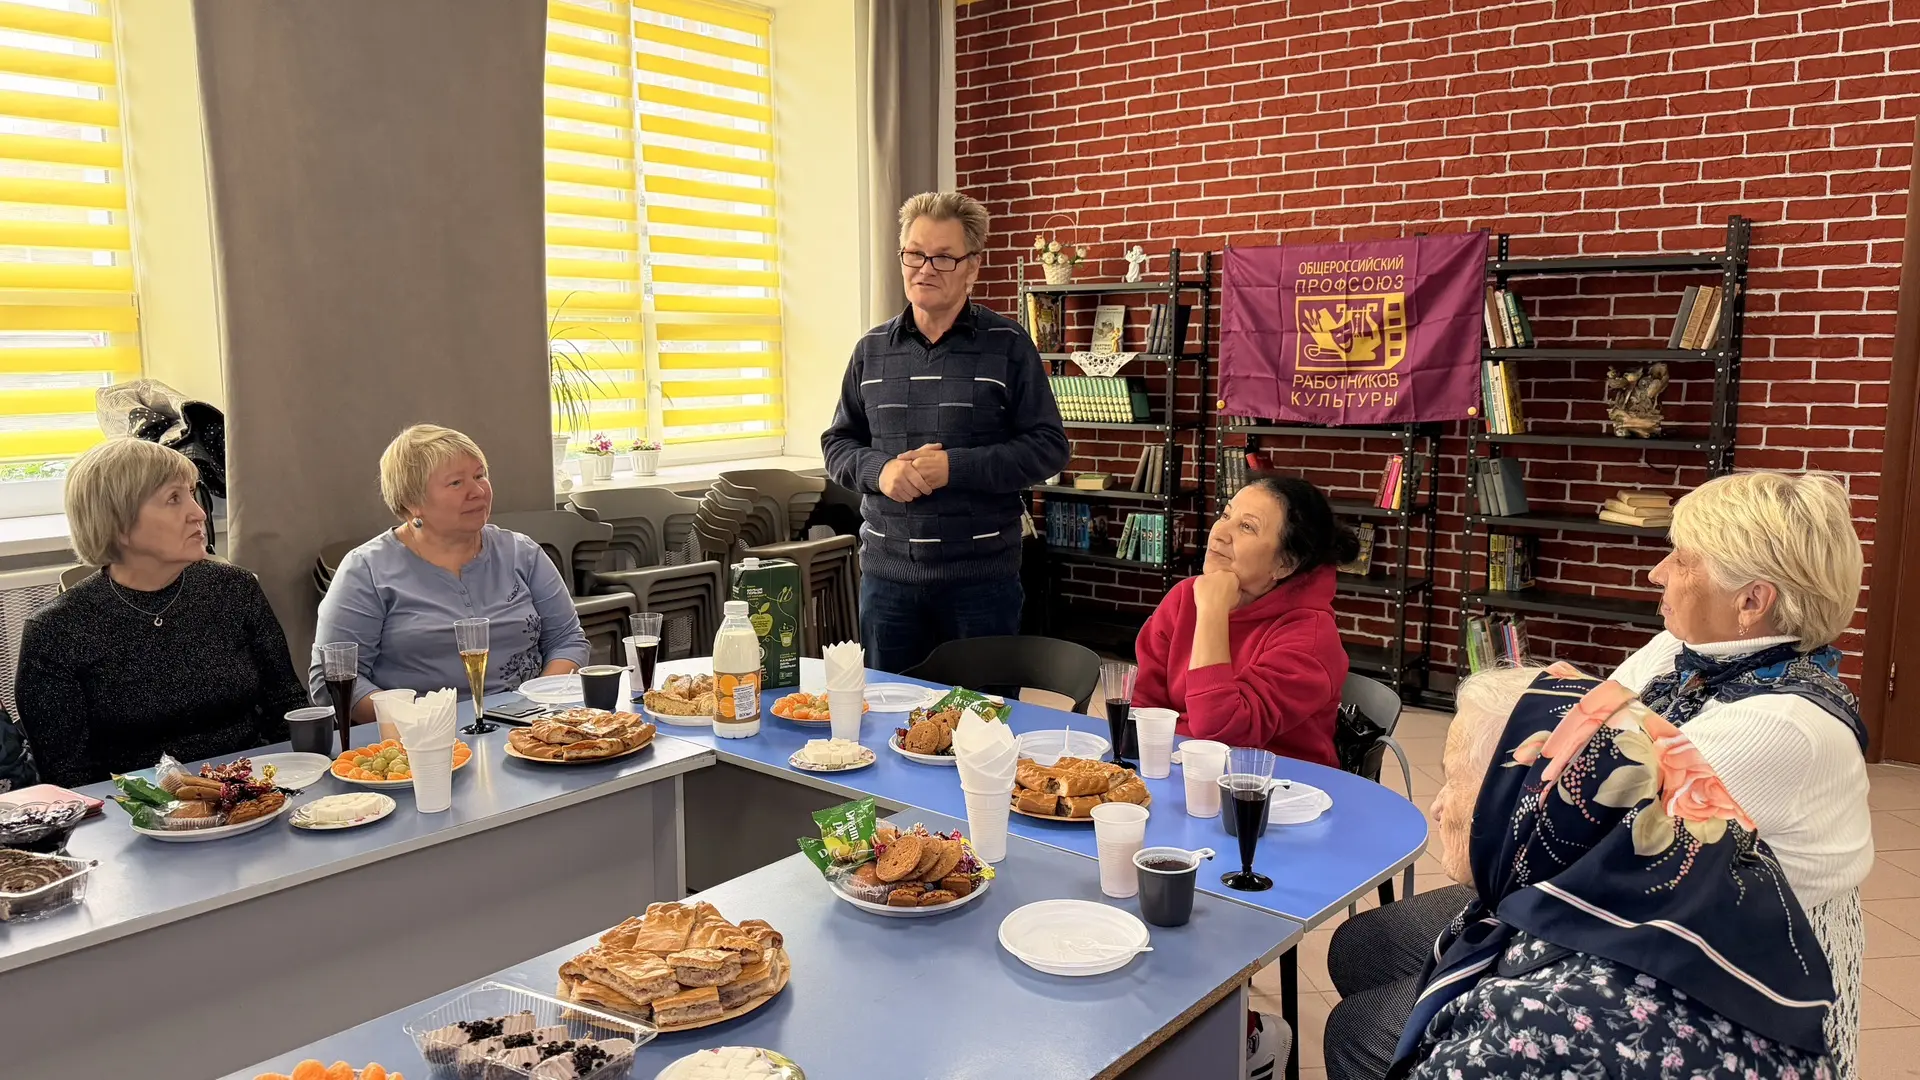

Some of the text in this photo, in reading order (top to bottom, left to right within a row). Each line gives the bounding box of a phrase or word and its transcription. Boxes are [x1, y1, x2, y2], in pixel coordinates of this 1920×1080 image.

[1298, 254, 1404, 275] ОБЩЕРОССИЙСКИЙ
[1295, 275, 1404, 293] ПРОФСОЮЗ
[1292, 372, 1399, 389] РАБОТНИКОВ
[1291, 391, 1398, 408] КУЛЬТУРЫ
